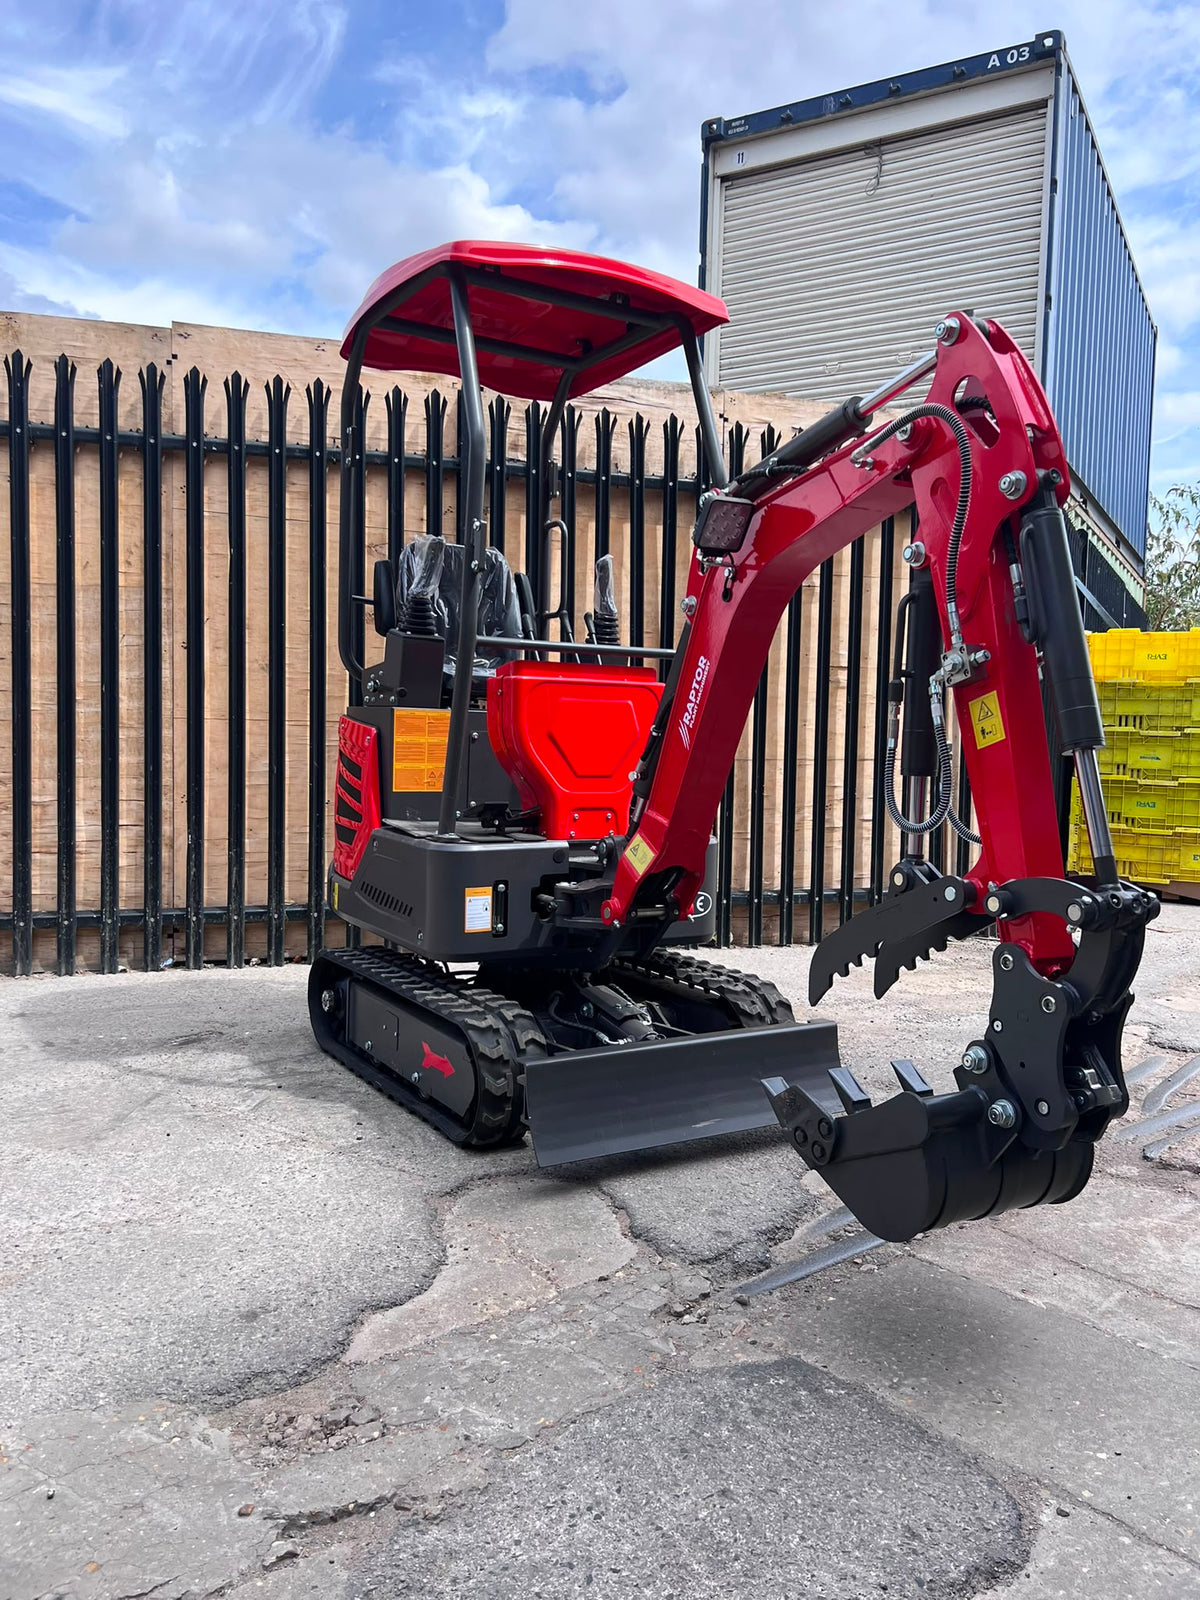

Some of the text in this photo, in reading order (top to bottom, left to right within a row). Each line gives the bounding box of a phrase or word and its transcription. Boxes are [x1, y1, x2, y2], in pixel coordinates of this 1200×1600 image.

[987, 46, 1031, 69] A 03
[737, 151, 744, 164] 11
[683, 655, 708, 725] RAPTOR
[689, 661, 711, 729] PLANT MACHINERY
